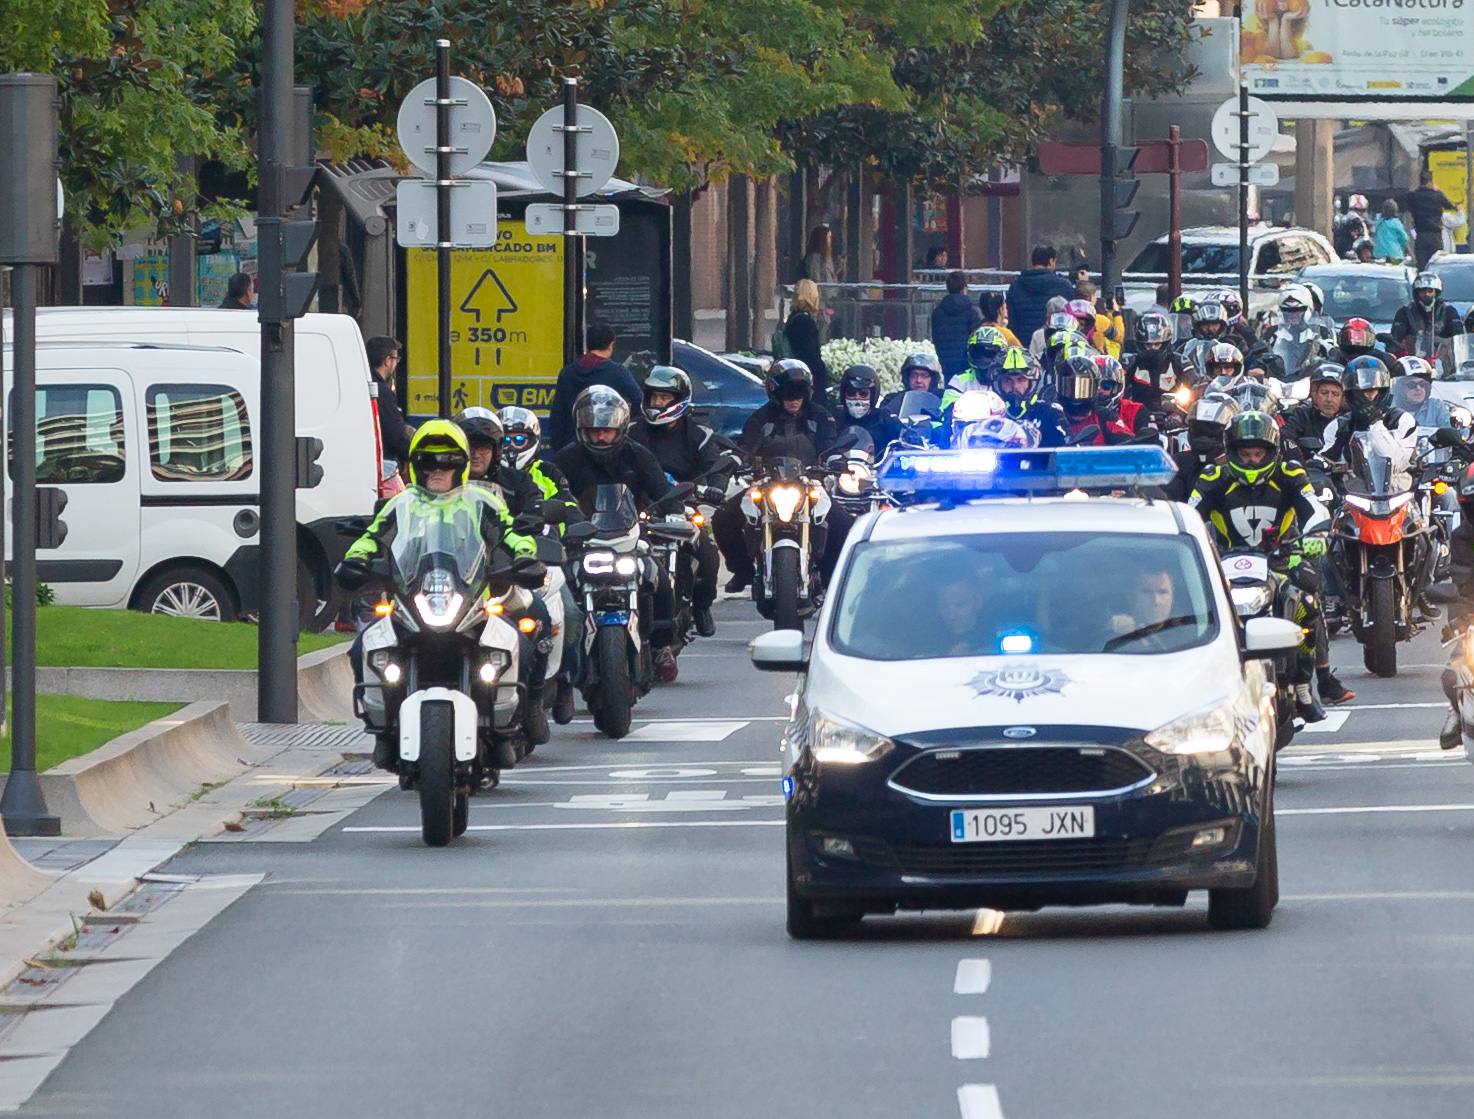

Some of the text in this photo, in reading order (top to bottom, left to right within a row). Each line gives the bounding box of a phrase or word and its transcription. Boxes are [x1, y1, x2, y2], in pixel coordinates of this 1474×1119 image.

[537, 243, 556, 253] BM
[468, 327, 507, 343] 350
[509, 330, 527, 343] m
[972, 811, 1085, 837] 1095 JXN
